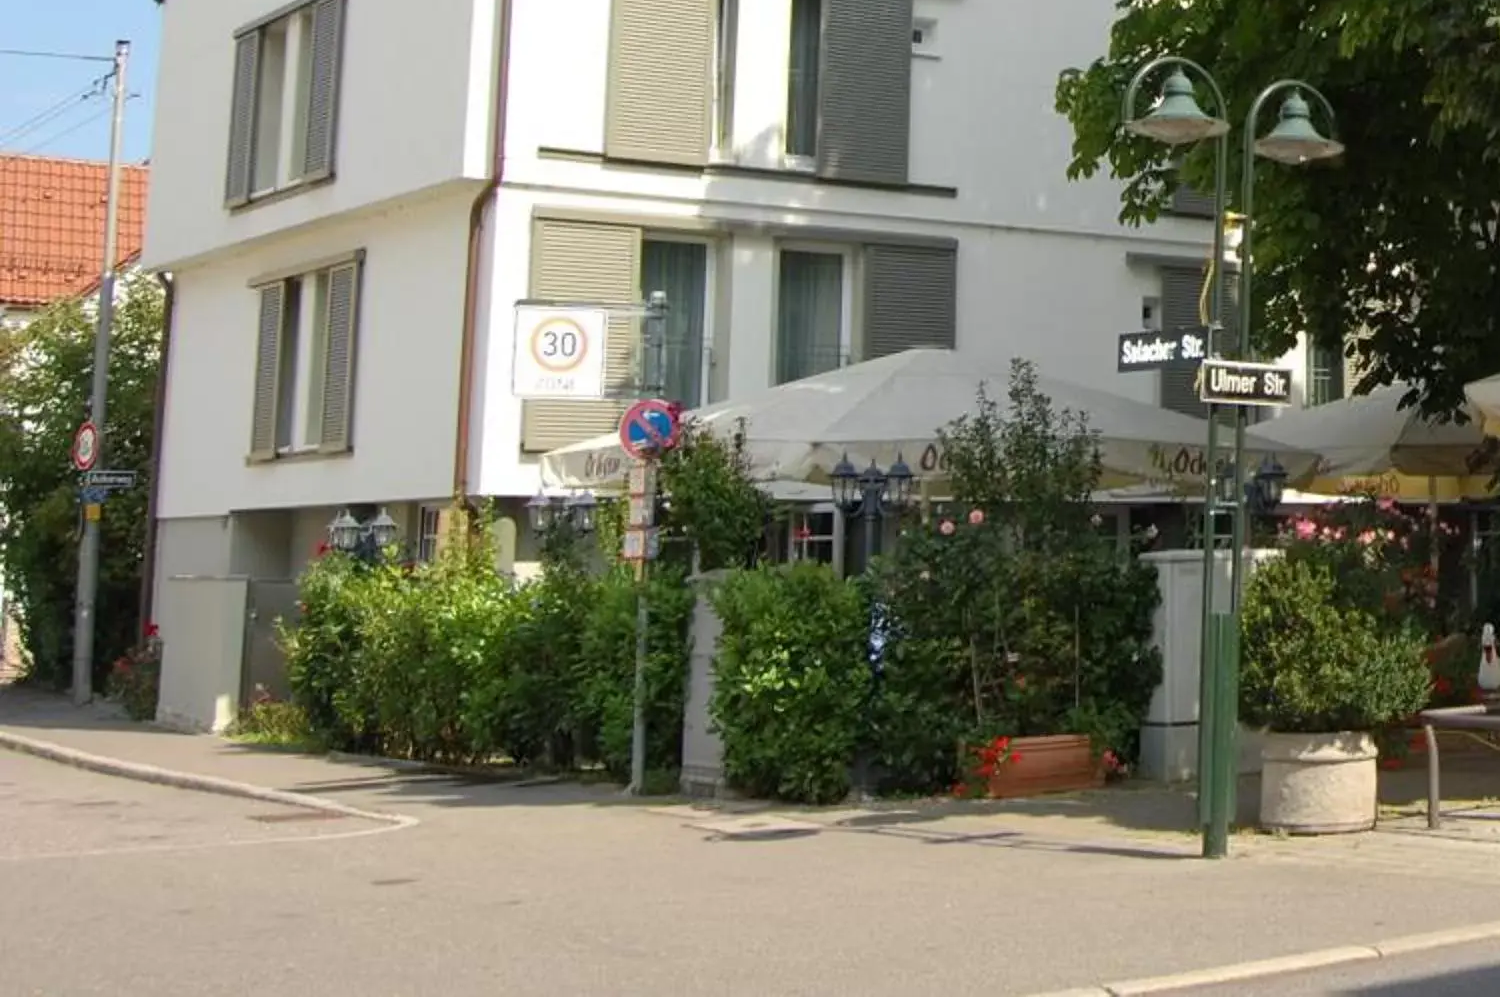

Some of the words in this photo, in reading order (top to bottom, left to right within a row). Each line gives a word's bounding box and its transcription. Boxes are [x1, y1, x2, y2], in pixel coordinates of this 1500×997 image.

[543, 331, 577, 357] 30
[1181, 334, 1204, 359] Str.
[1211, 368, 1257, 393] Ulmer
[1264, 372, 1287, 396] Str.
